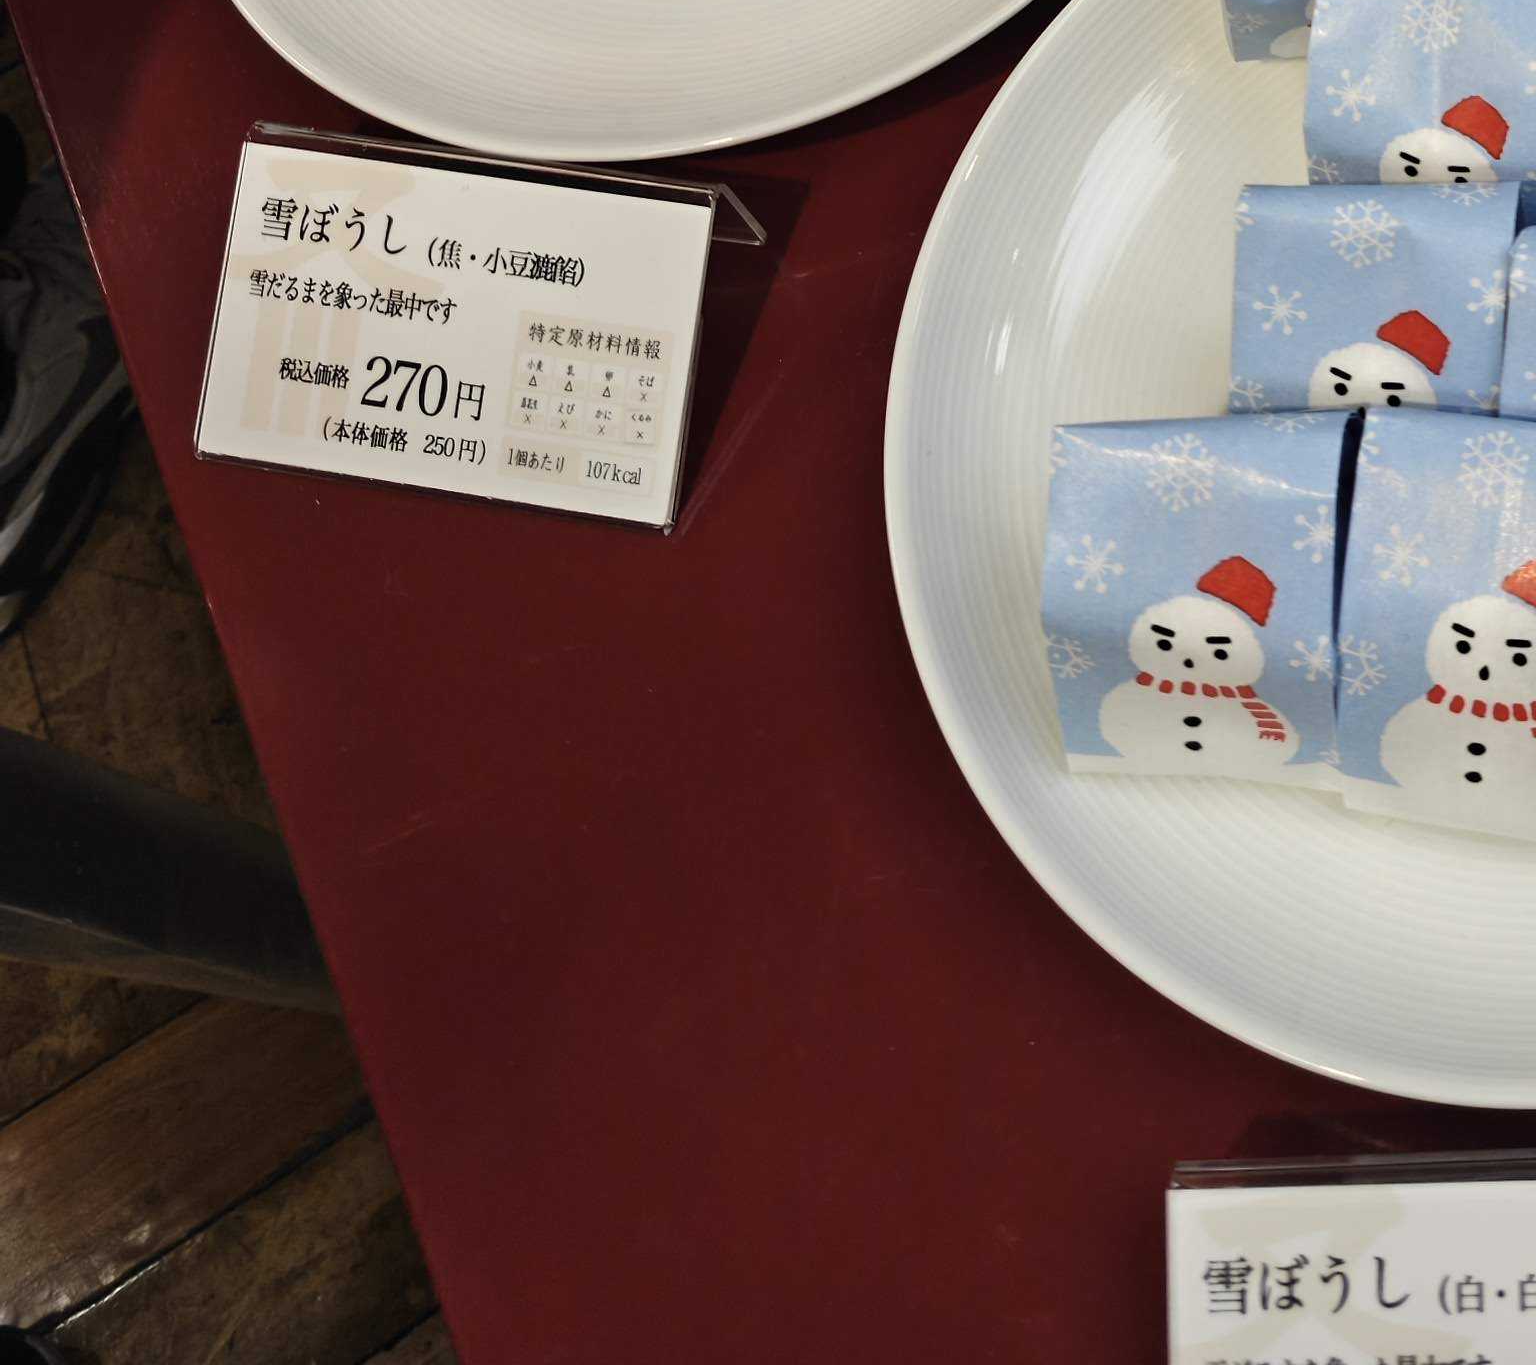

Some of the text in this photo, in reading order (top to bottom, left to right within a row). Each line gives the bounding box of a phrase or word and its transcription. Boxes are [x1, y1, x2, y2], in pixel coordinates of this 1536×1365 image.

[261, 195, 408, 257] 雪ぼうし
[248, 268, 459, 327] 雪だるまを象った最中です
[528, 322, 663, 360] 特定原材料情報
[278, 355, 487, 423] 税込価格 270円
[507, 448, 643, 486] 1個あたり 107kcal
[1203, 1253, 1412, 1317] 雪ぼうし
